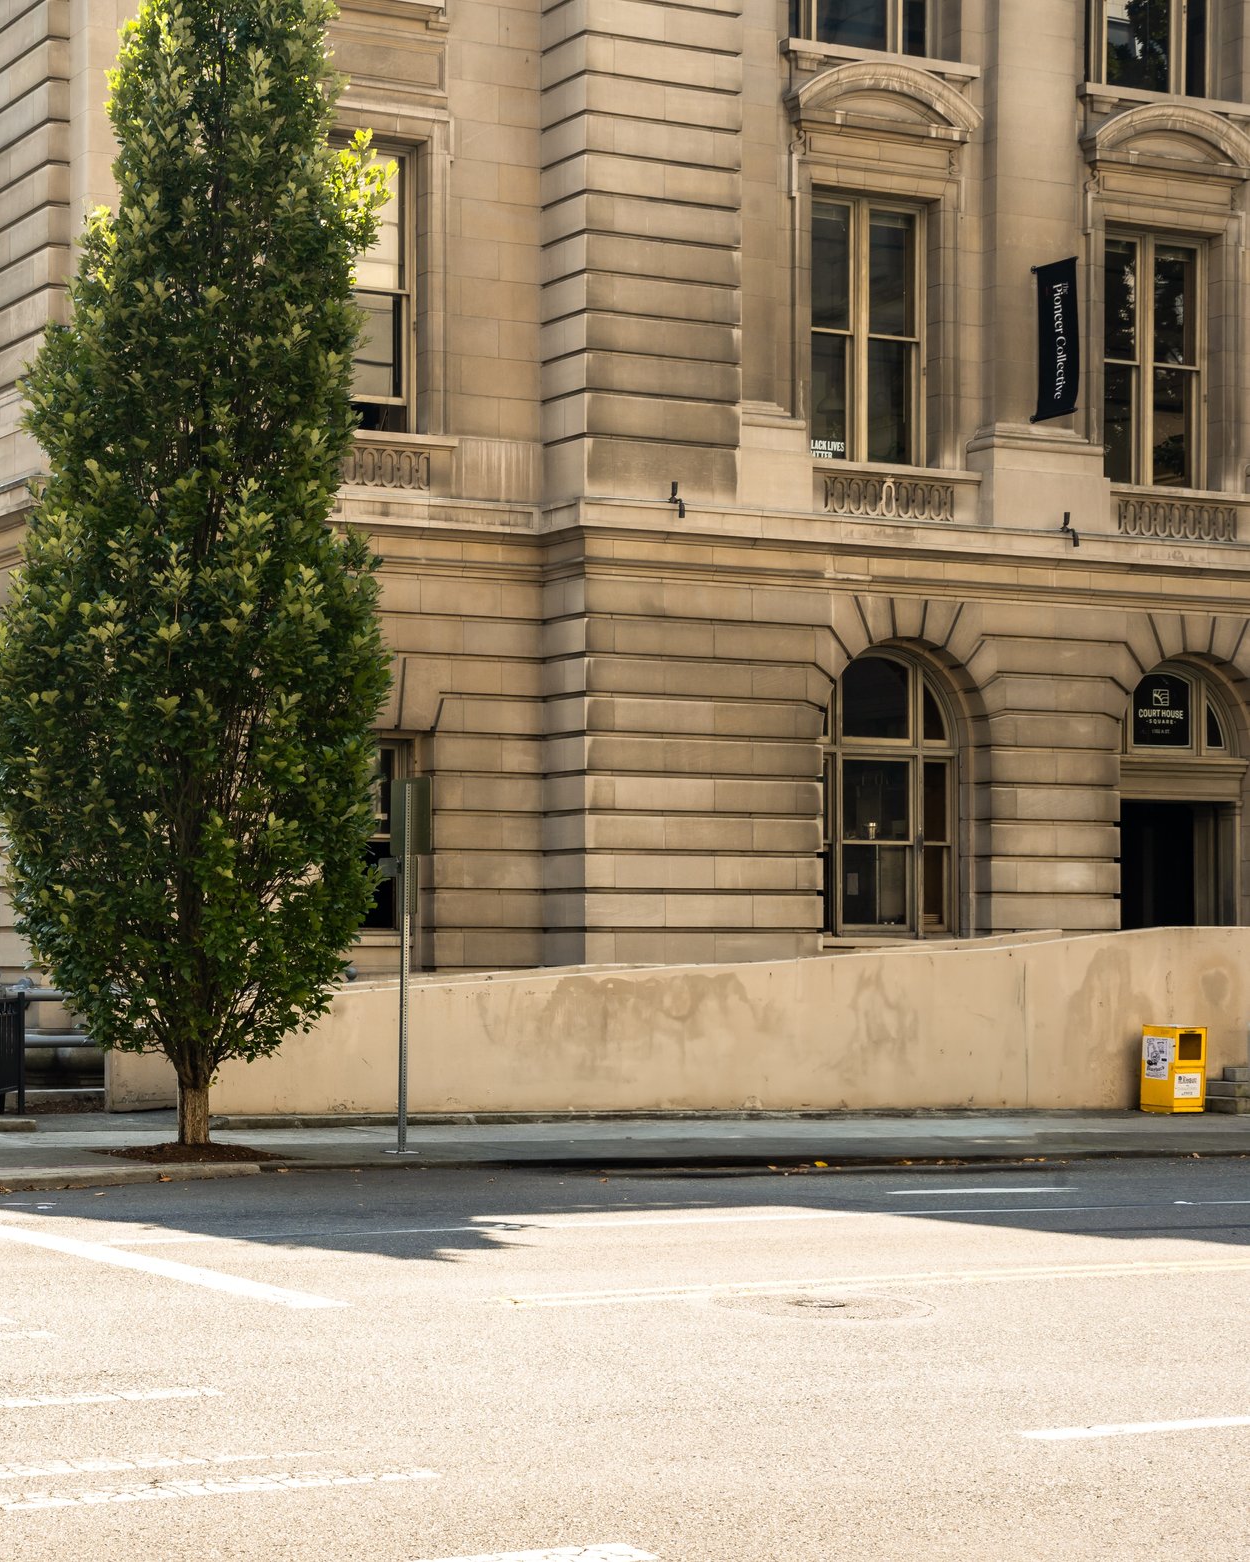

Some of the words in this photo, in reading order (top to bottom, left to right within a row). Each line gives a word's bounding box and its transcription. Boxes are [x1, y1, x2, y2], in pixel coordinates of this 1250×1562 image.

[1053, 283, 1064, 334] Pioneer
[1053, 336, 1067, 400] Collective
[811, 440, 827, 450] LACK
[828, 441, 845, 452] LIVES
[811, 450, 833, 458] ATTER
[1138, 709, 1160, 718] COURT
[1161, 709, 1184, 720] HOUSE
